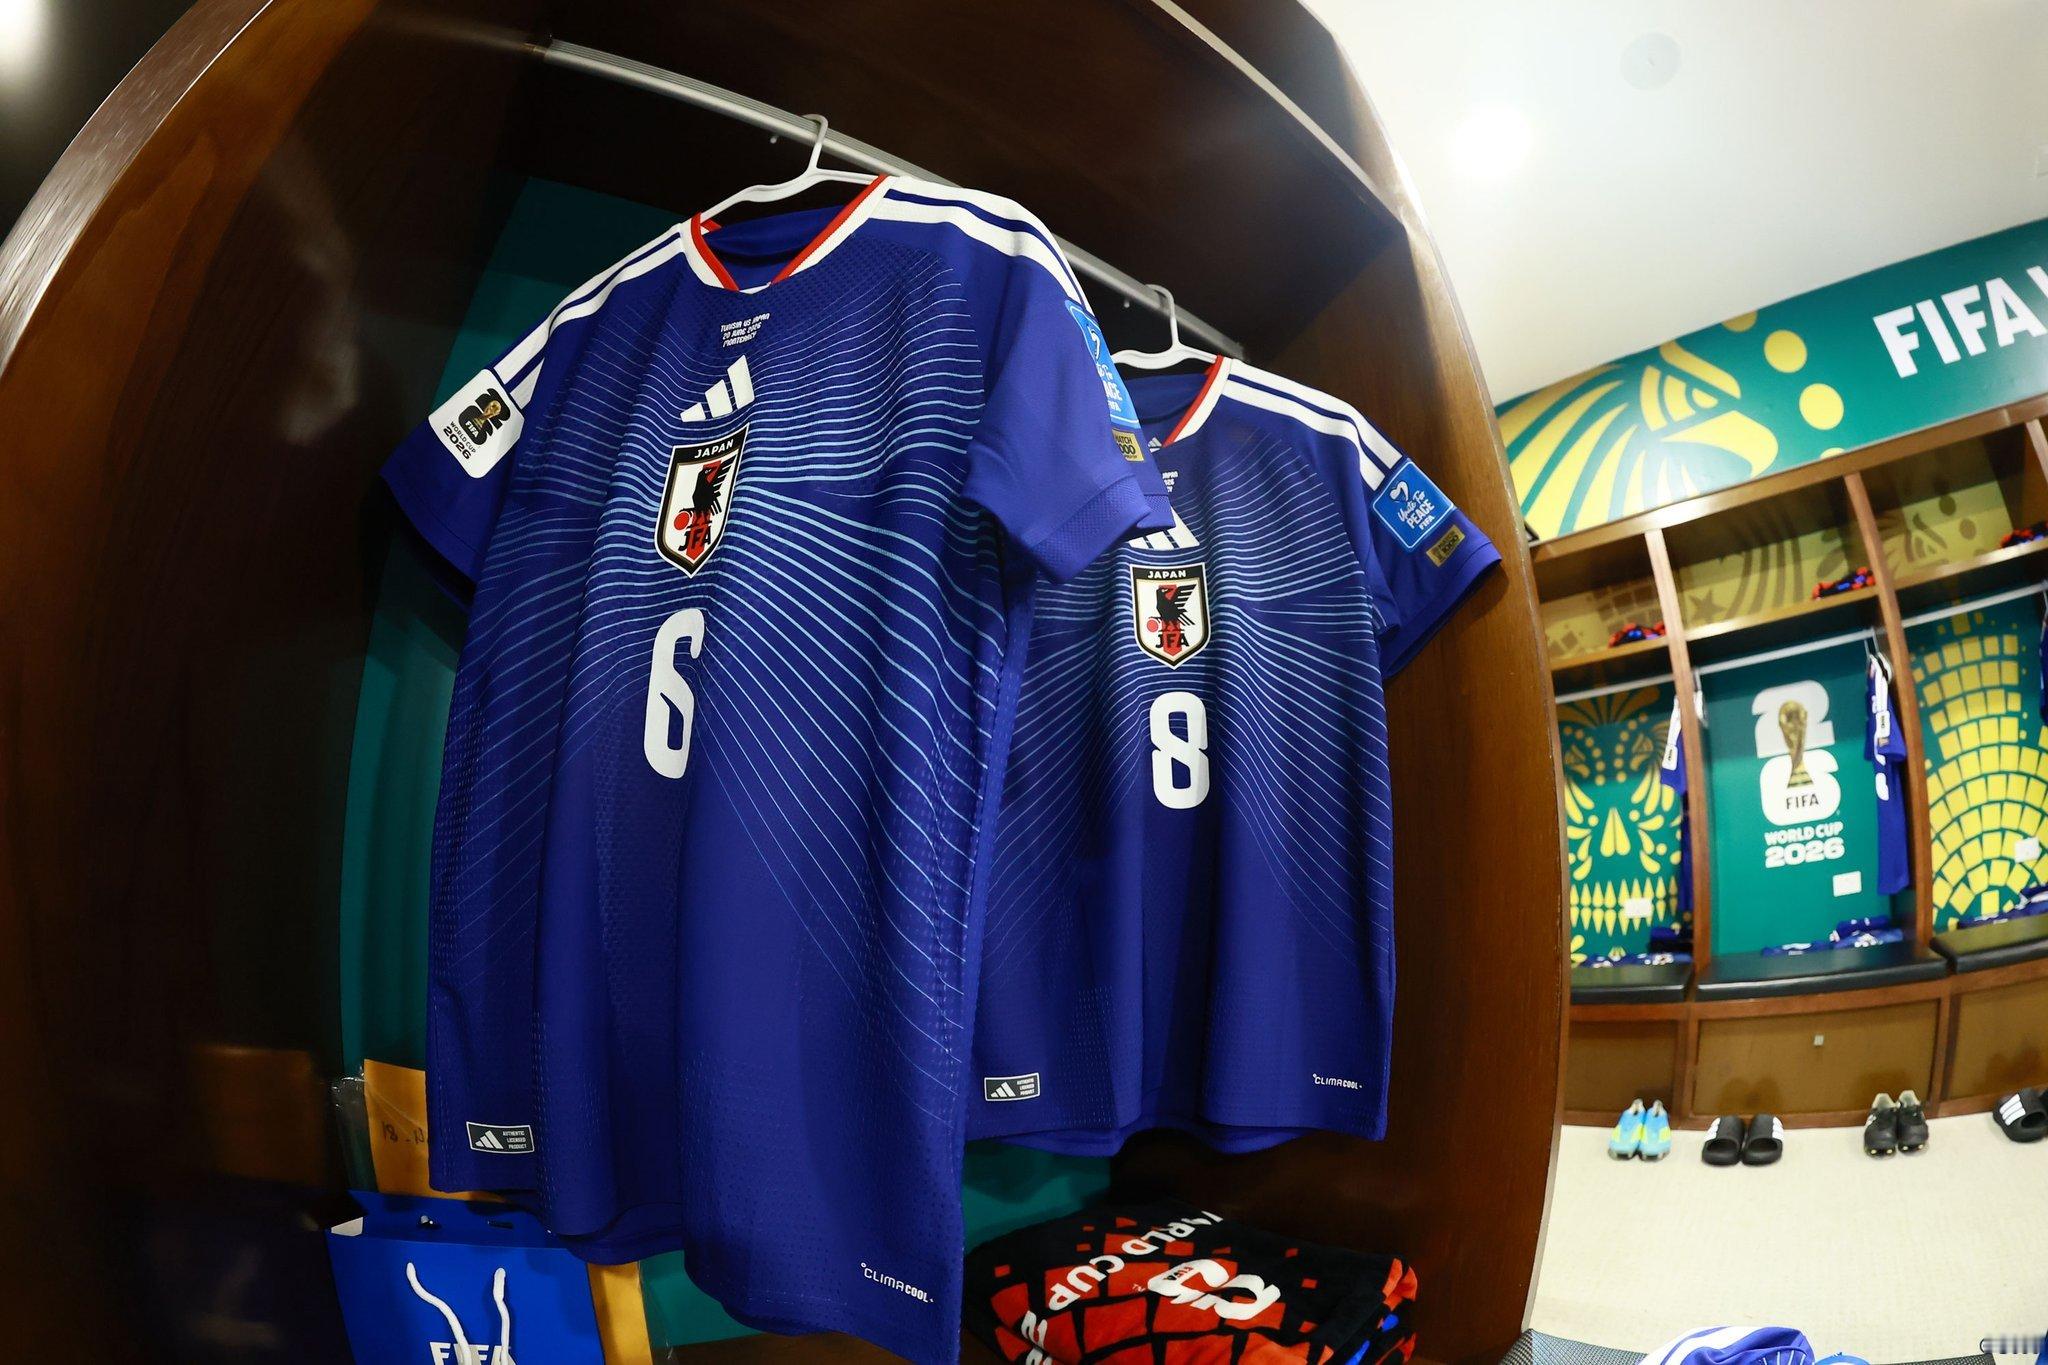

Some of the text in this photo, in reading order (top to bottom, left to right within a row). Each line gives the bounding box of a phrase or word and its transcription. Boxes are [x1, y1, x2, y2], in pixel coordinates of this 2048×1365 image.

[1873, 277, 2048, 378] FIFA
[443, 426, 472, 460] 2026
[450, 421, 476, 453] WORLD CUP
[465, 421, 479, 438] FIFA
[694, 439, 734, 459] JAPAN
[1407, 499, 1435, 529] PEACE
[1419, 515, 1435, 530] FIFA
[678, 526, 712, 551] JFA
[1147, 569, 1187, 579] JAPAN
[1155, 633, 1190, 649] JFA
[644, 608, 705, 779] 6
[1149, 691, 1210, 809] 8
[1786, 793, 1819, 809] FIFA
[1764, 821, 1844, 846] WORLD CUP
[1765, 836, 1845, 868] 2026
[1048, 1254, 1124, 1311] CUP
